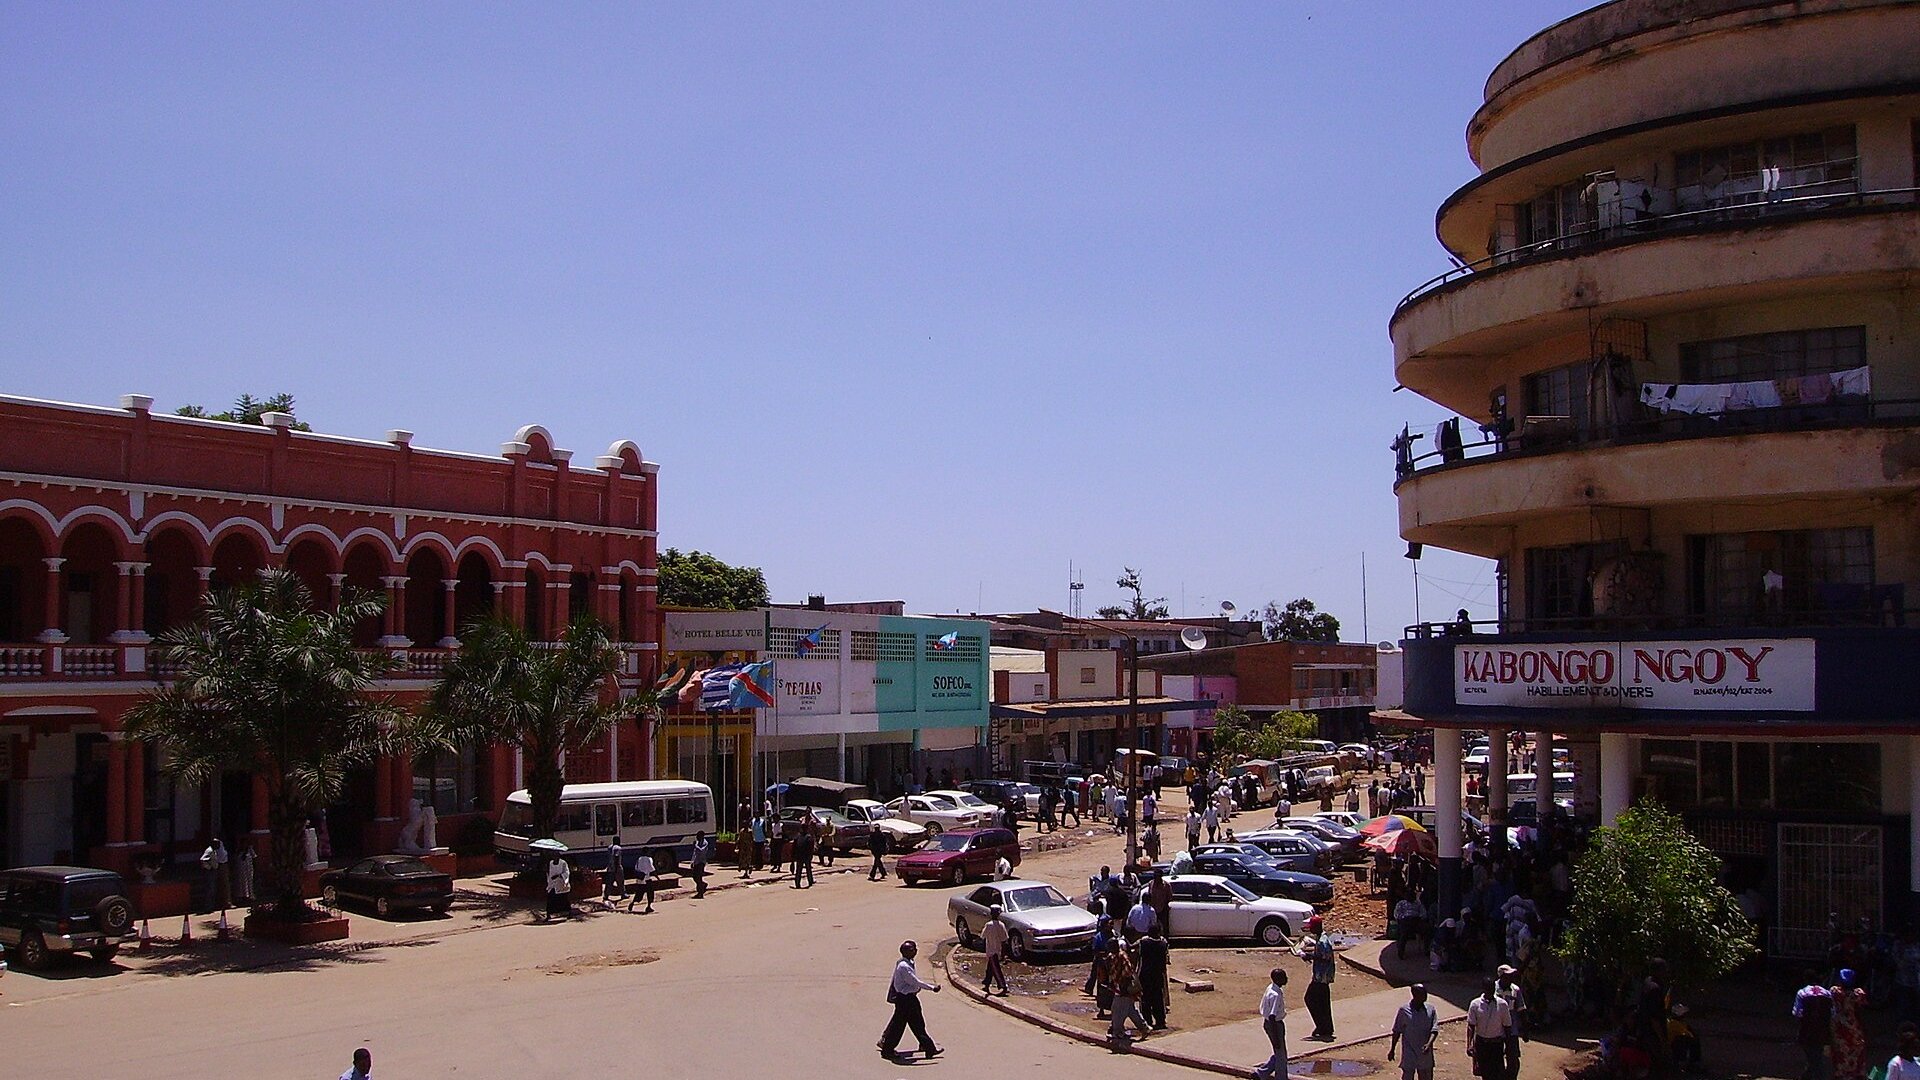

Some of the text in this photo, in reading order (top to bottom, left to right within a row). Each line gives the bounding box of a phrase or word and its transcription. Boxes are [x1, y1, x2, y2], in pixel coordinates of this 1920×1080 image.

[684, 628, 763, 638] HOTEL BELLE VUE
[1463, 646, 1774, 685] KABONGO NGOY
[933, 675, 964, 690] SOFCO
[1526, 686, 1603, 697] HABILLEMENT
[1610, 686, 1654, 699] DVERS
